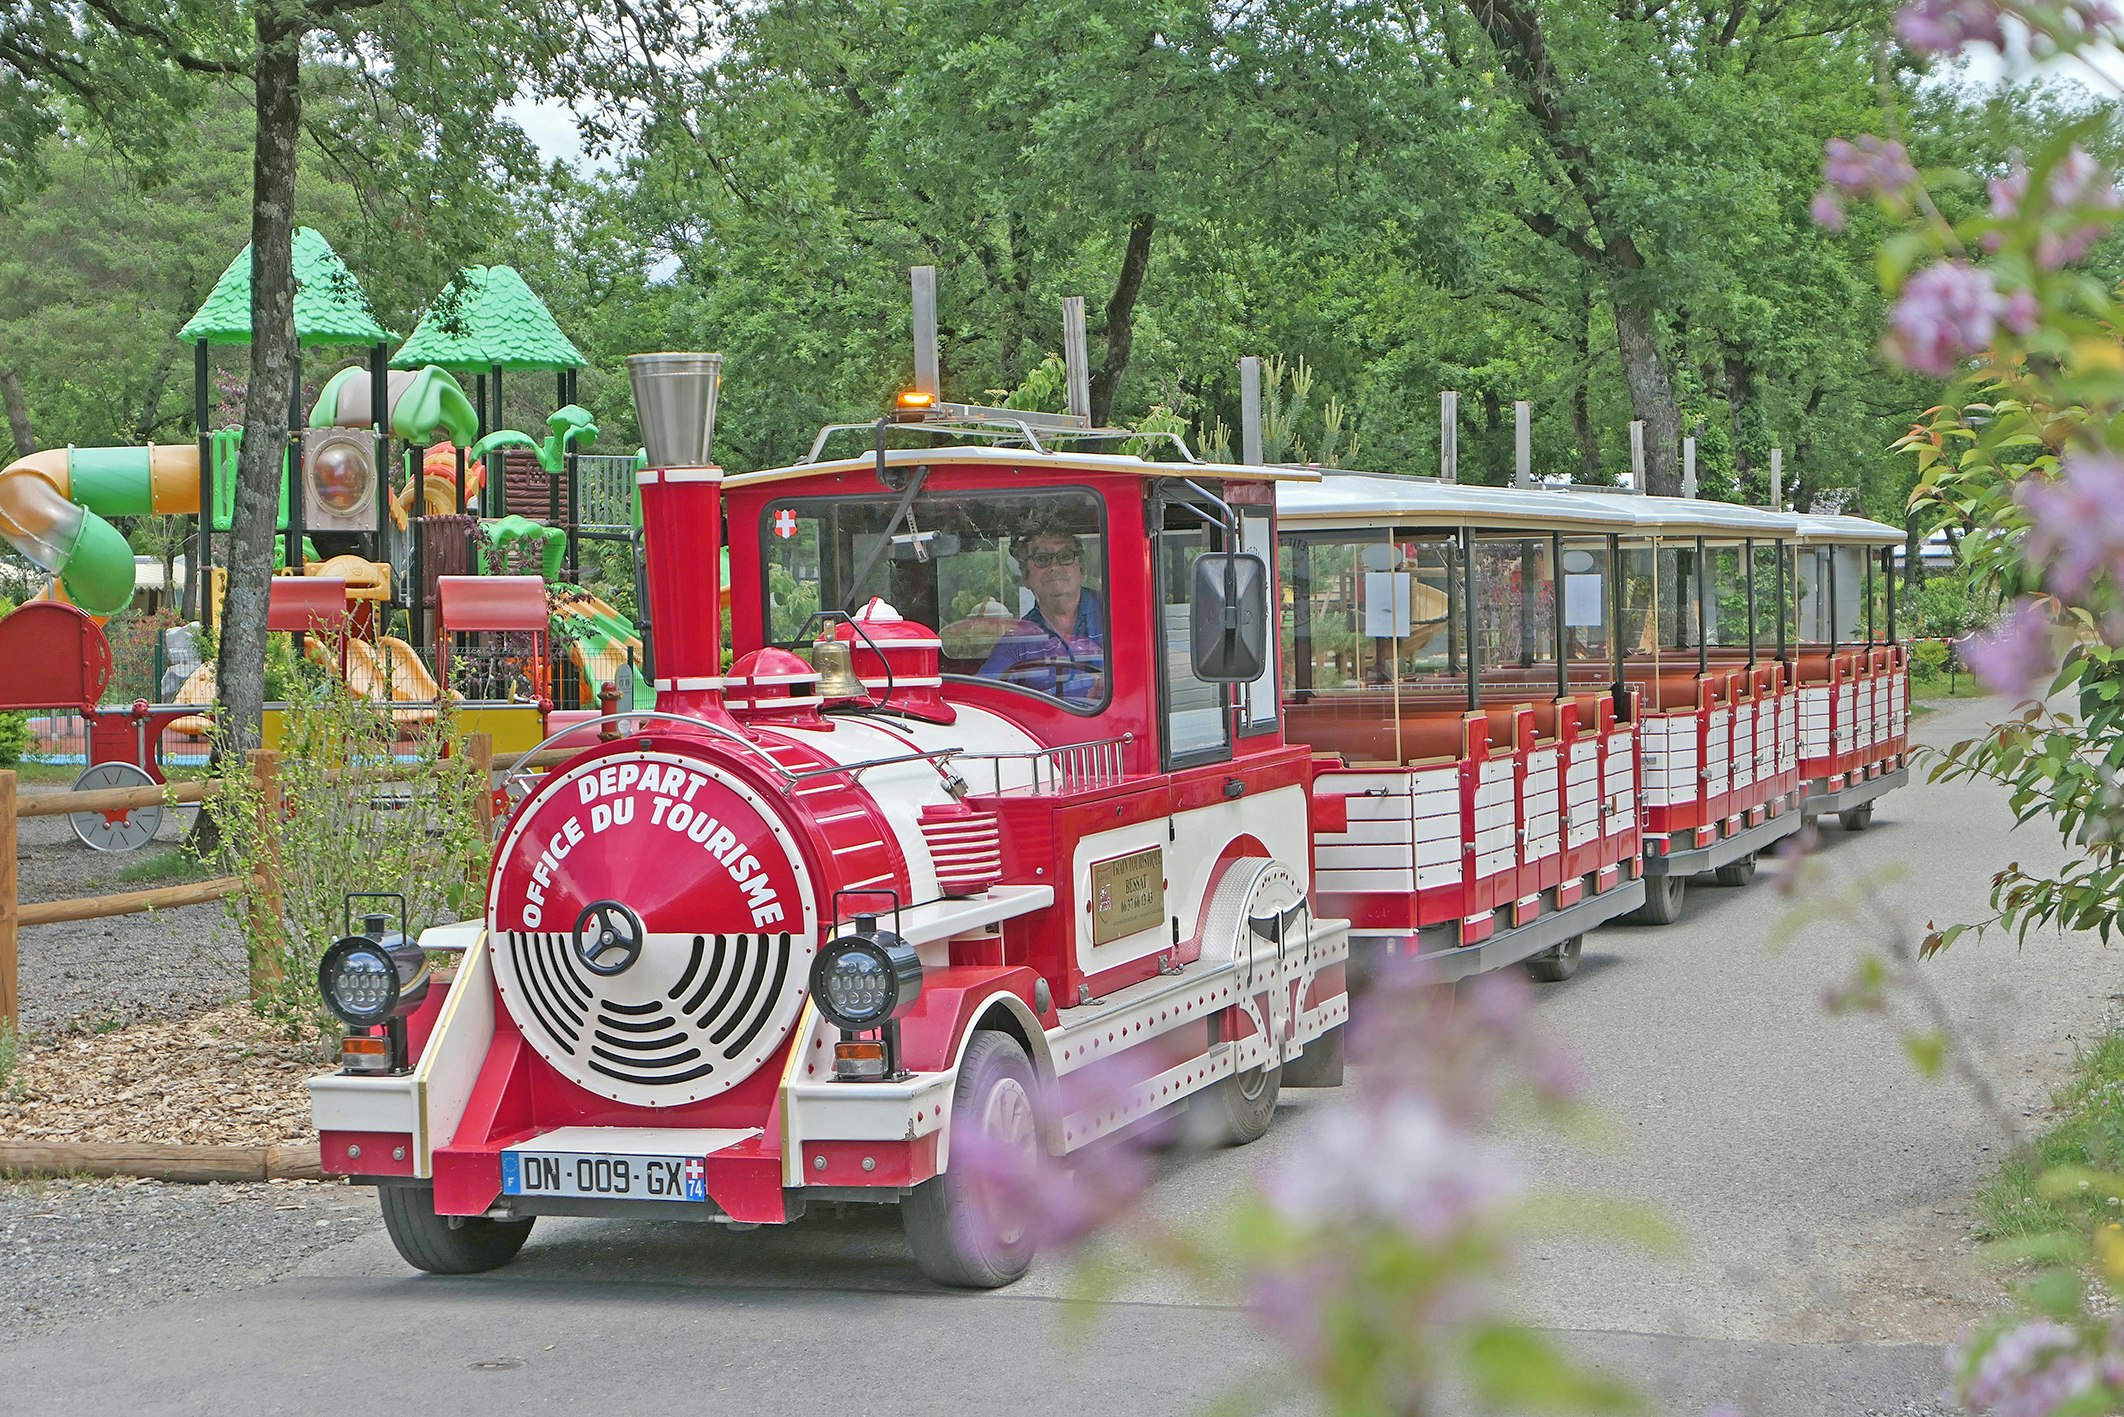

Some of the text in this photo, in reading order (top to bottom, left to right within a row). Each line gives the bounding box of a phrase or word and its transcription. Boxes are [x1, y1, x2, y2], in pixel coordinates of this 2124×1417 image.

[578, 764, 707, 804] DEPART
[522, 796, 785, 929] OFFICE DU TOURISME
[1125, 874, 1148, 894] BESSAT
[508, 1177, 514, 1187] F
[688, 1179, 703, 1197] 74
